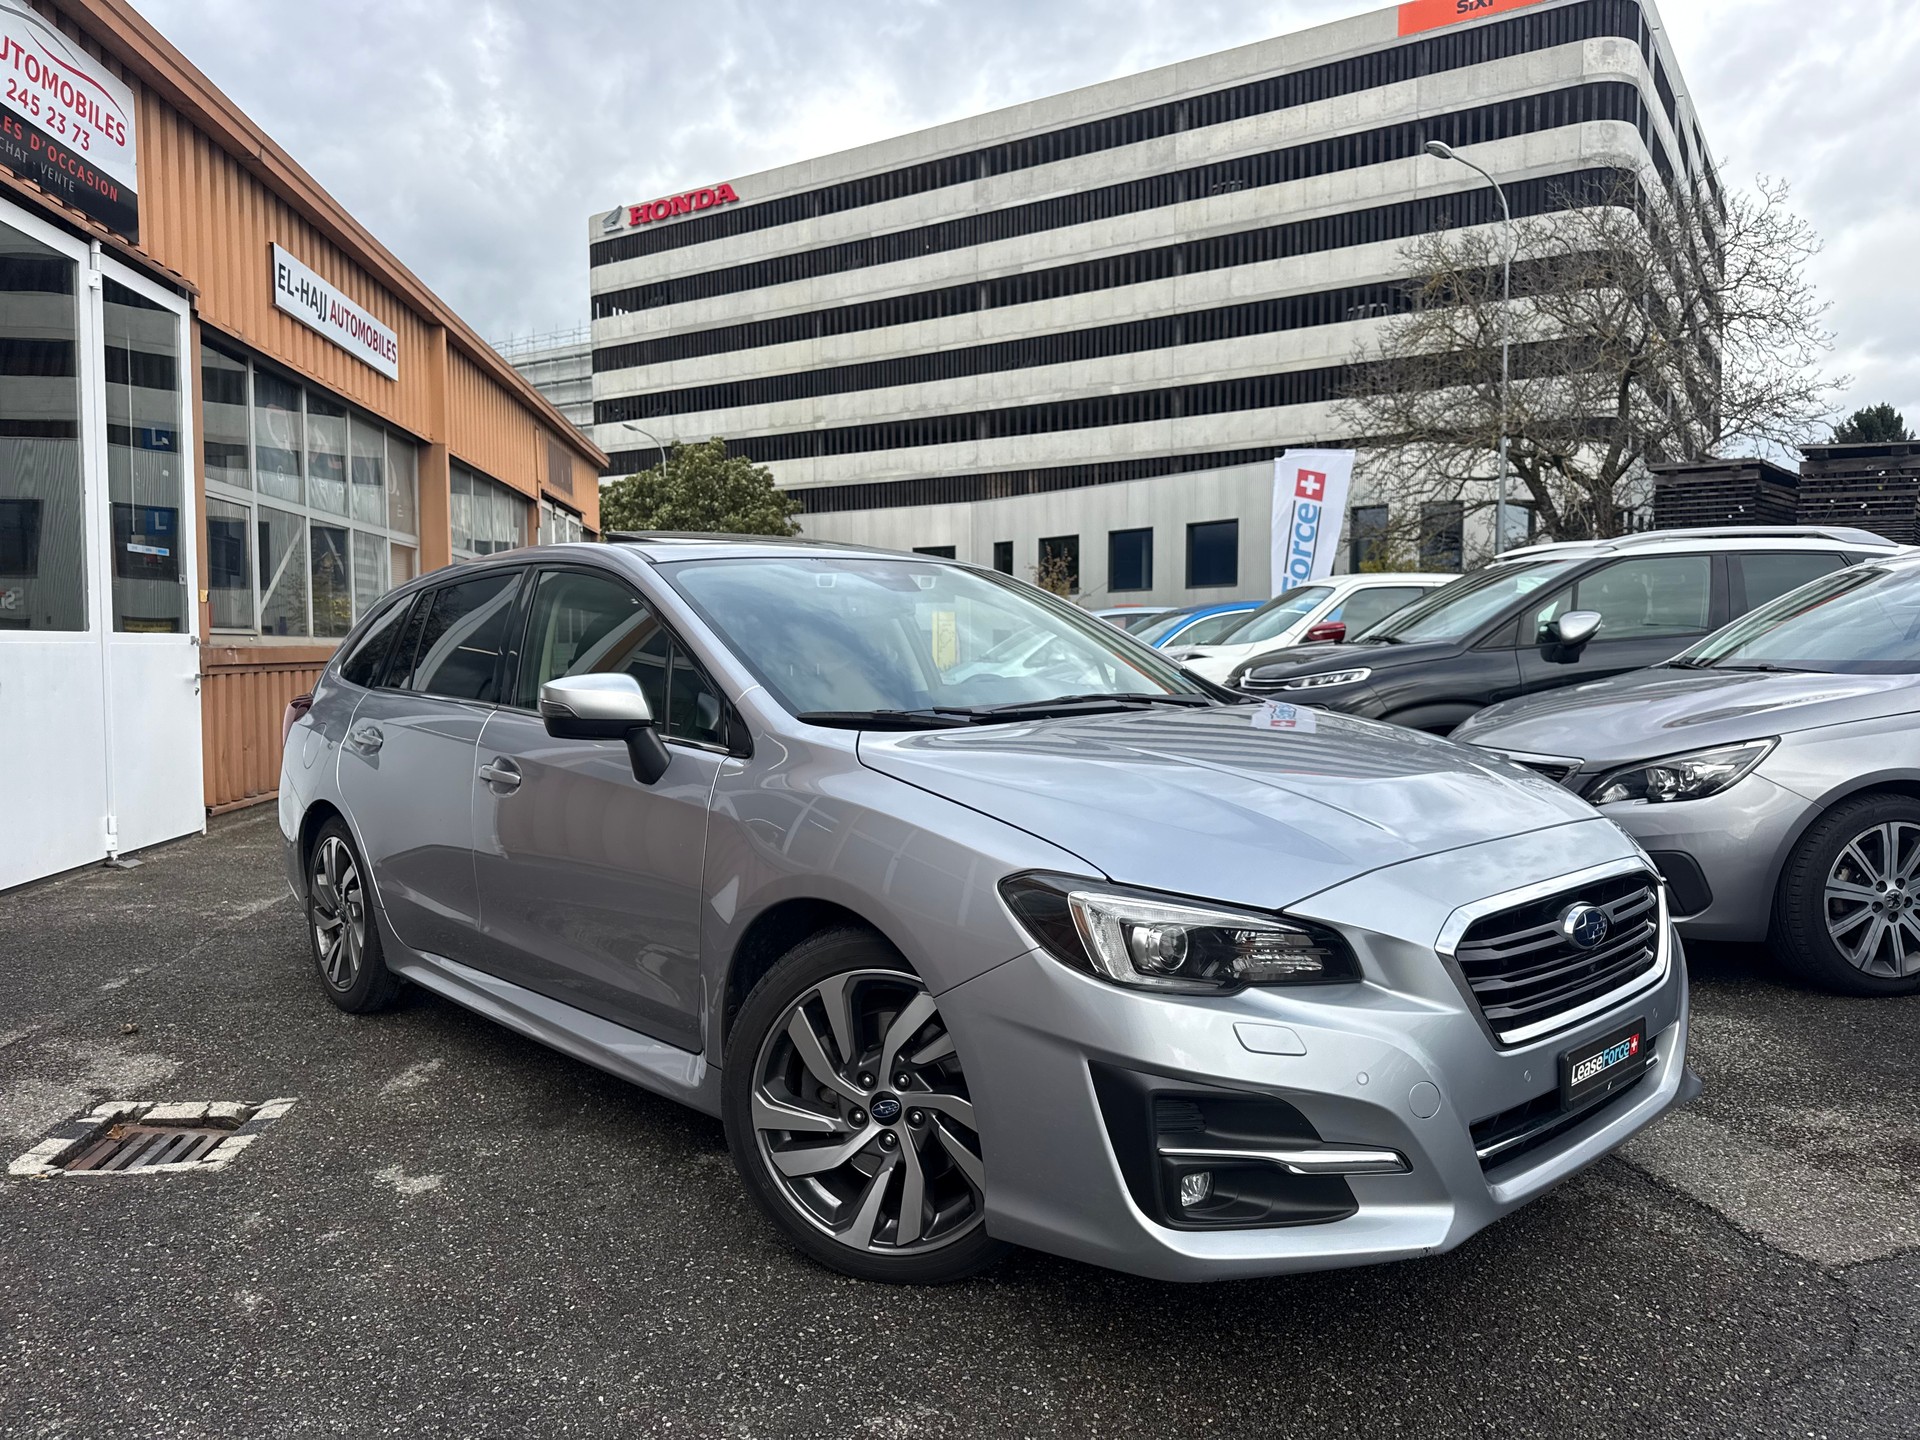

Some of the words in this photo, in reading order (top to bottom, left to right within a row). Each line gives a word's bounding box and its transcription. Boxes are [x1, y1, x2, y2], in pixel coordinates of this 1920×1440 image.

[6, 78, 41, 117] 245
[46, 106, 67, 135] 23
[72, 122, 91, 151] 73
[0, 115, 23, 140] ES
[30, 133, 118, 203] D'OCCASION
[40, 161, 75, 193] VENTE
[628, 183, 739, 227] HONDA
[277, 262, 328, 322] EL-HAJJ
[329, 299, 397, 364] AUTOMOBILES
[1571, 1040, 1631, 1084] LeaseForce
